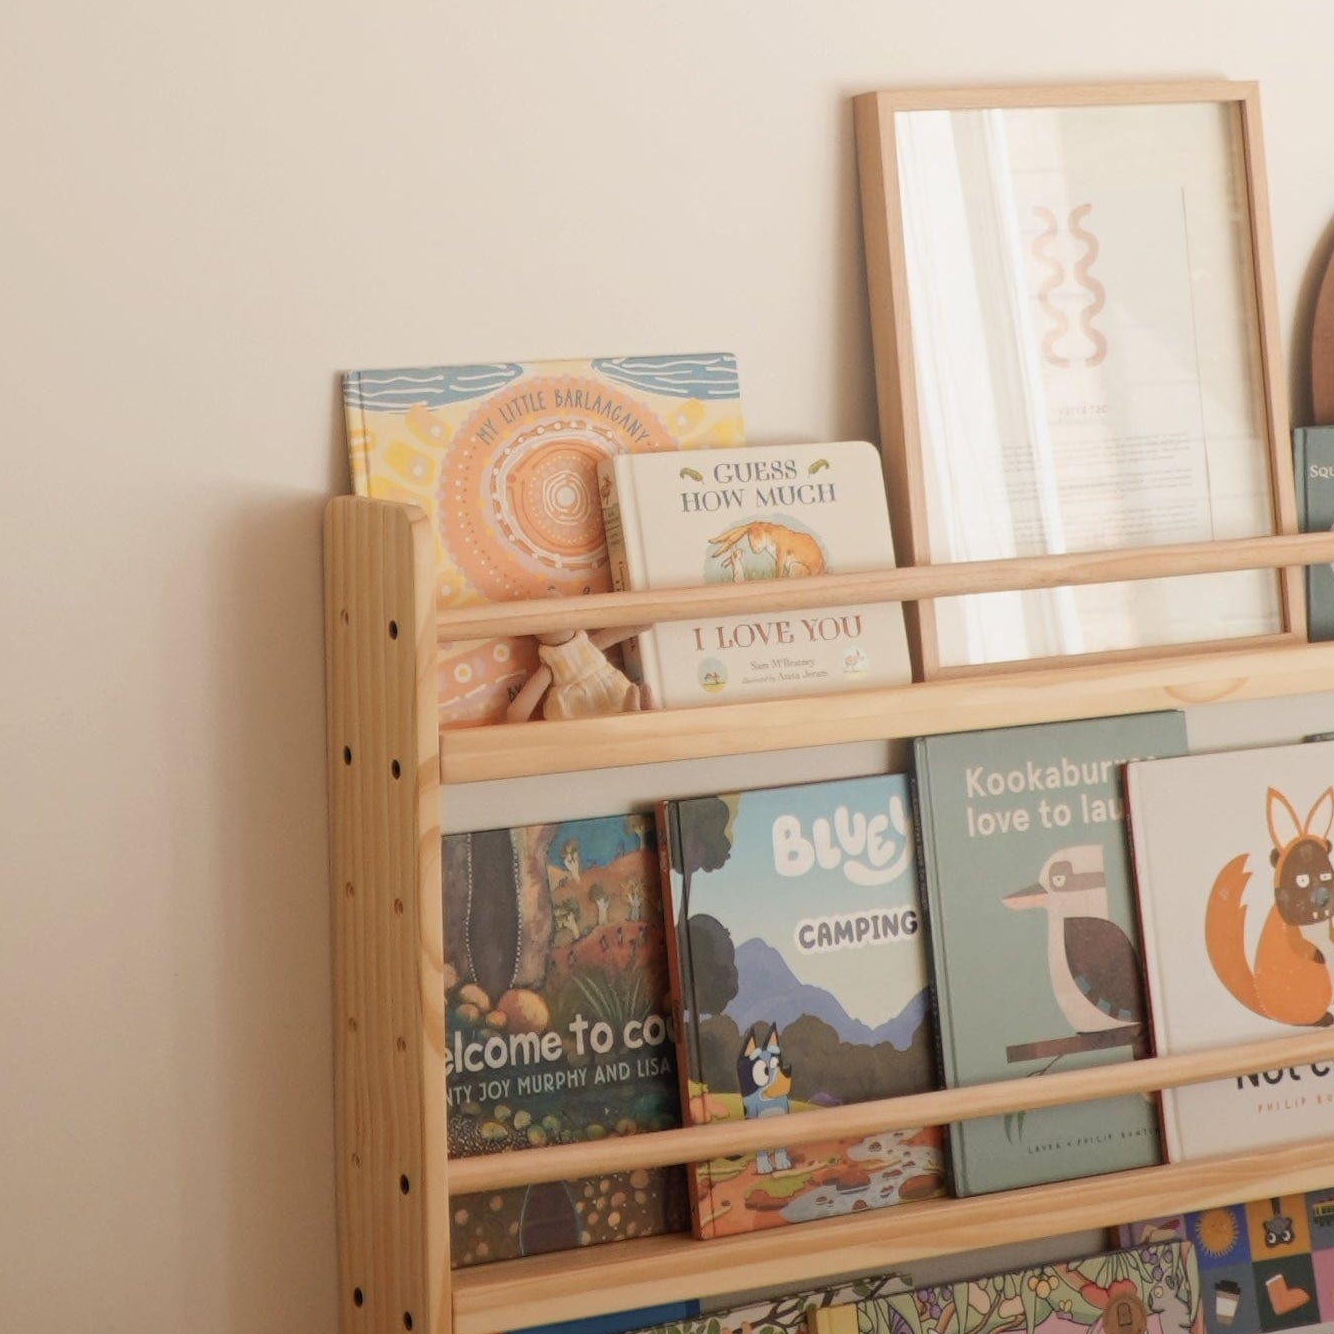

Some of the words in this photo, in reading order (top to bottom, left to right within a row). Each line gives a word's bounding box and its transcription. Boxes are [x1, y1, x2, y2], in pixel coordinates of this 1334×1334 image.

[476, 419, 499, 446] MY
[499, 391, 546, 424] LITTLE
[554, 389, 650, 443] BARLAAGANY
[713, 459, 798, 484] GUESS
[680, 488, 746, 513] HOW
[756, 483, 837, 508] MUCH
[693, 628, 705, 651] I
[716, 620, 795, 650] LOVE
[800, 615, 862, 642] YOU
[966, 806, 1031, 837] love
[1038, 799, 1071, 829] to
[798, 910, 918, 949] CAMPING
[568, 1014, 614, 1055] to
[479, 1079, 511, 1102] JOY
[517, 1068, 588, 1096] MURPHY
[594, 1062, 631, 1085] AND
[637, 1057, 672, 1079] LISA
